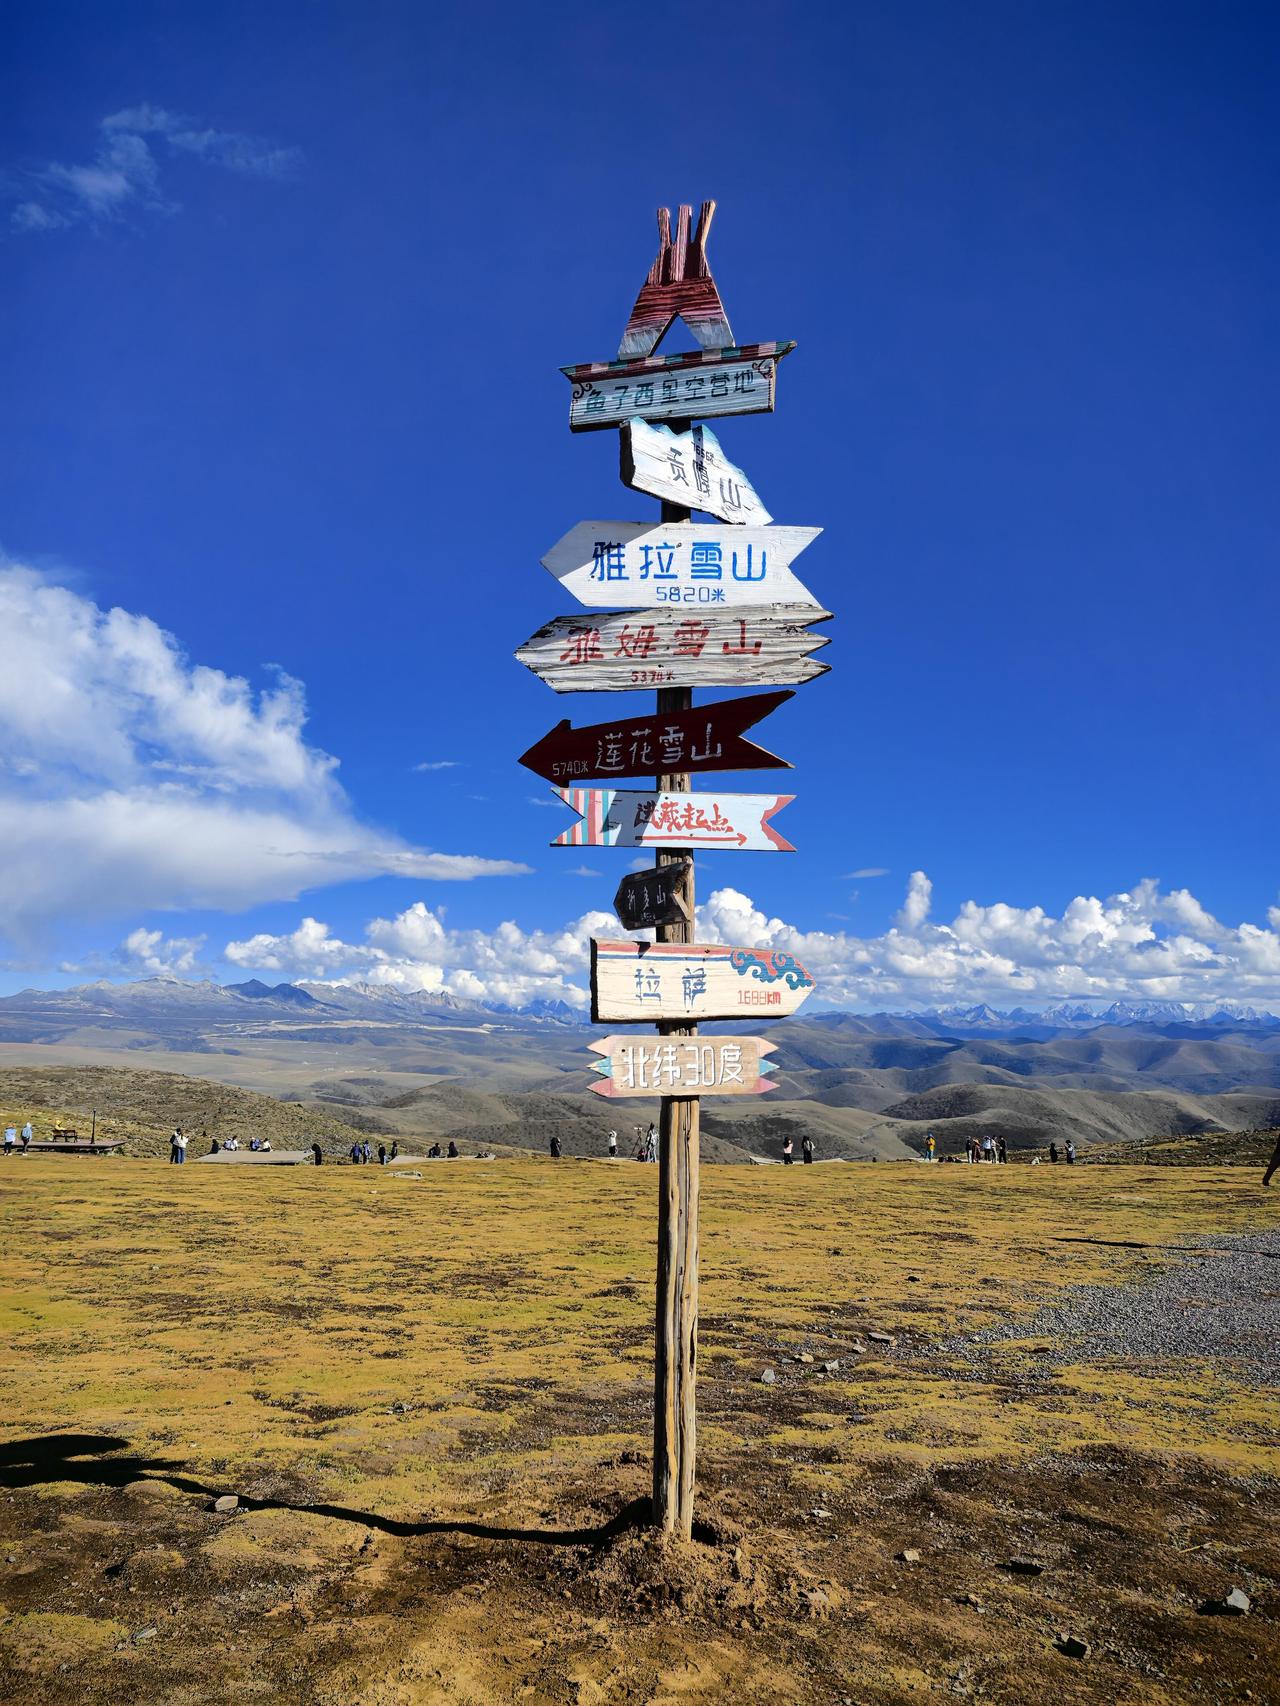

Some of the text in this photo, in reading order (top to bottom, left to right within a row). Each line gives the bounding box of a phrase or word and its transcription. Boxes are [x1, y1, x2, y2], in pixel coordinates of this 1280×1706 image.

[590, 541, 767, 582] 雅拉雪山
[656, 586, 726, 602] 5820米
[559, 619, 763, 665] 雅姆雪山
[594, 722, 722, 771] 莲花雪山
[552, 760, 589, 776] 5740米
[634, 967, 707, 1009] 拉萨
[621, 1043, 745, 1088] 北纬30度
